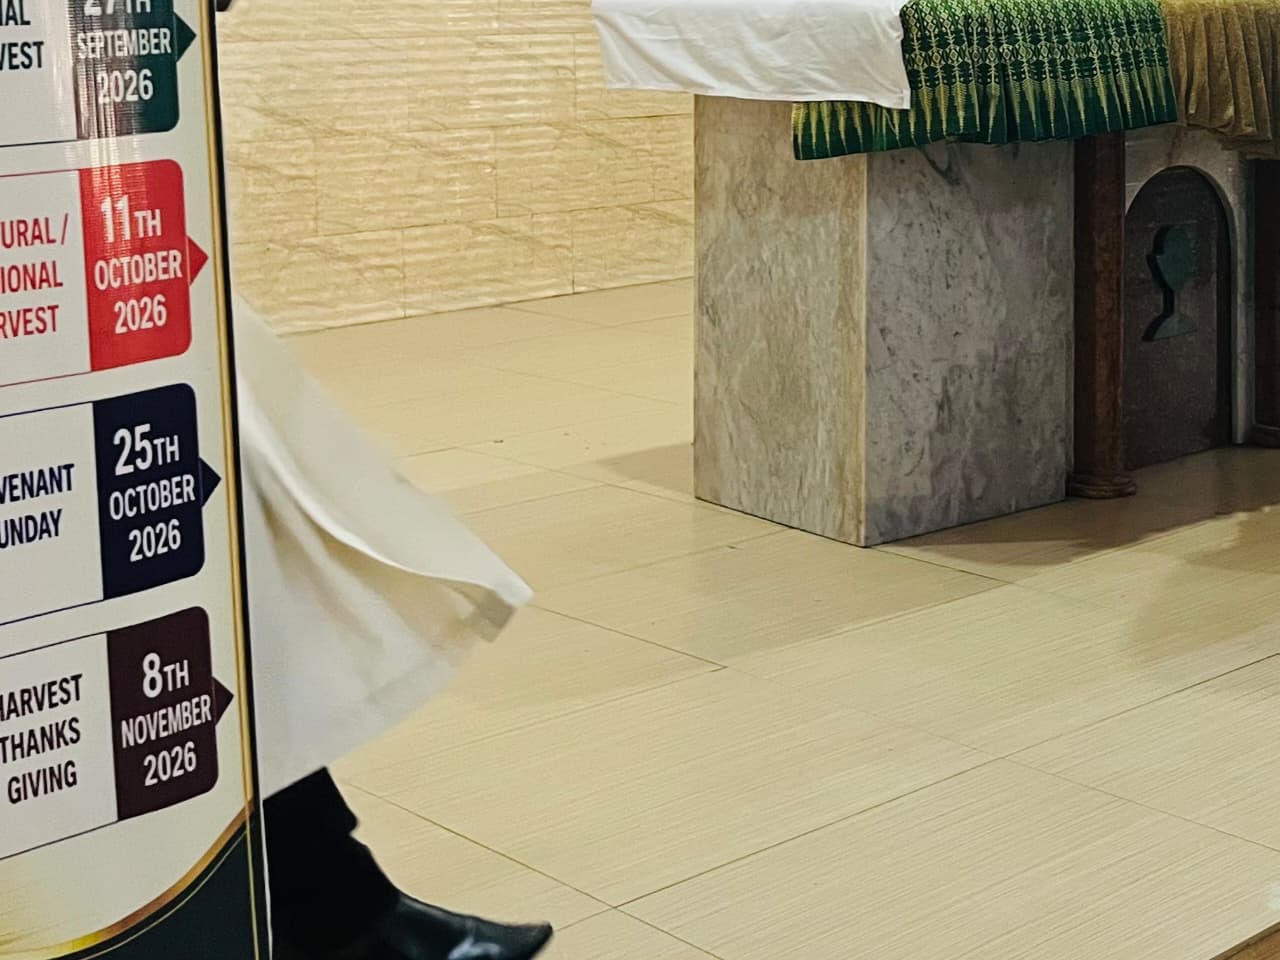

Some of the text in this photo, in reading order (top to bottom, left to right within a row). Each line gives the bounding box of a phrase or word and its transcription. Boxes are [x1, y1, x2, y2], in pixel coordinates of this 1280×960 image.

[77, 28, 172, 59] SEPTEMBER
[97, 69, 154, 104] 2026
[101, 195, 162, 243] 11TH
[0, 260, 63, 294] IONAL
[94, 249, 183, 291] OCTOBER
[114, 294, 168, 335] 2026
[113, 423, 180, 476] 25TH
[109, 474, 196, 520] OCTOBER
[128, 518, 181, 562] 2026
[142, 652, 190, 698] 8TH
[0, 717, 81, 764] THANKS
[121, 694, 212, 748] NOVEMBER
[8, 760, 77, 804] GIVING
[143, 741, 197, 786] 2026
